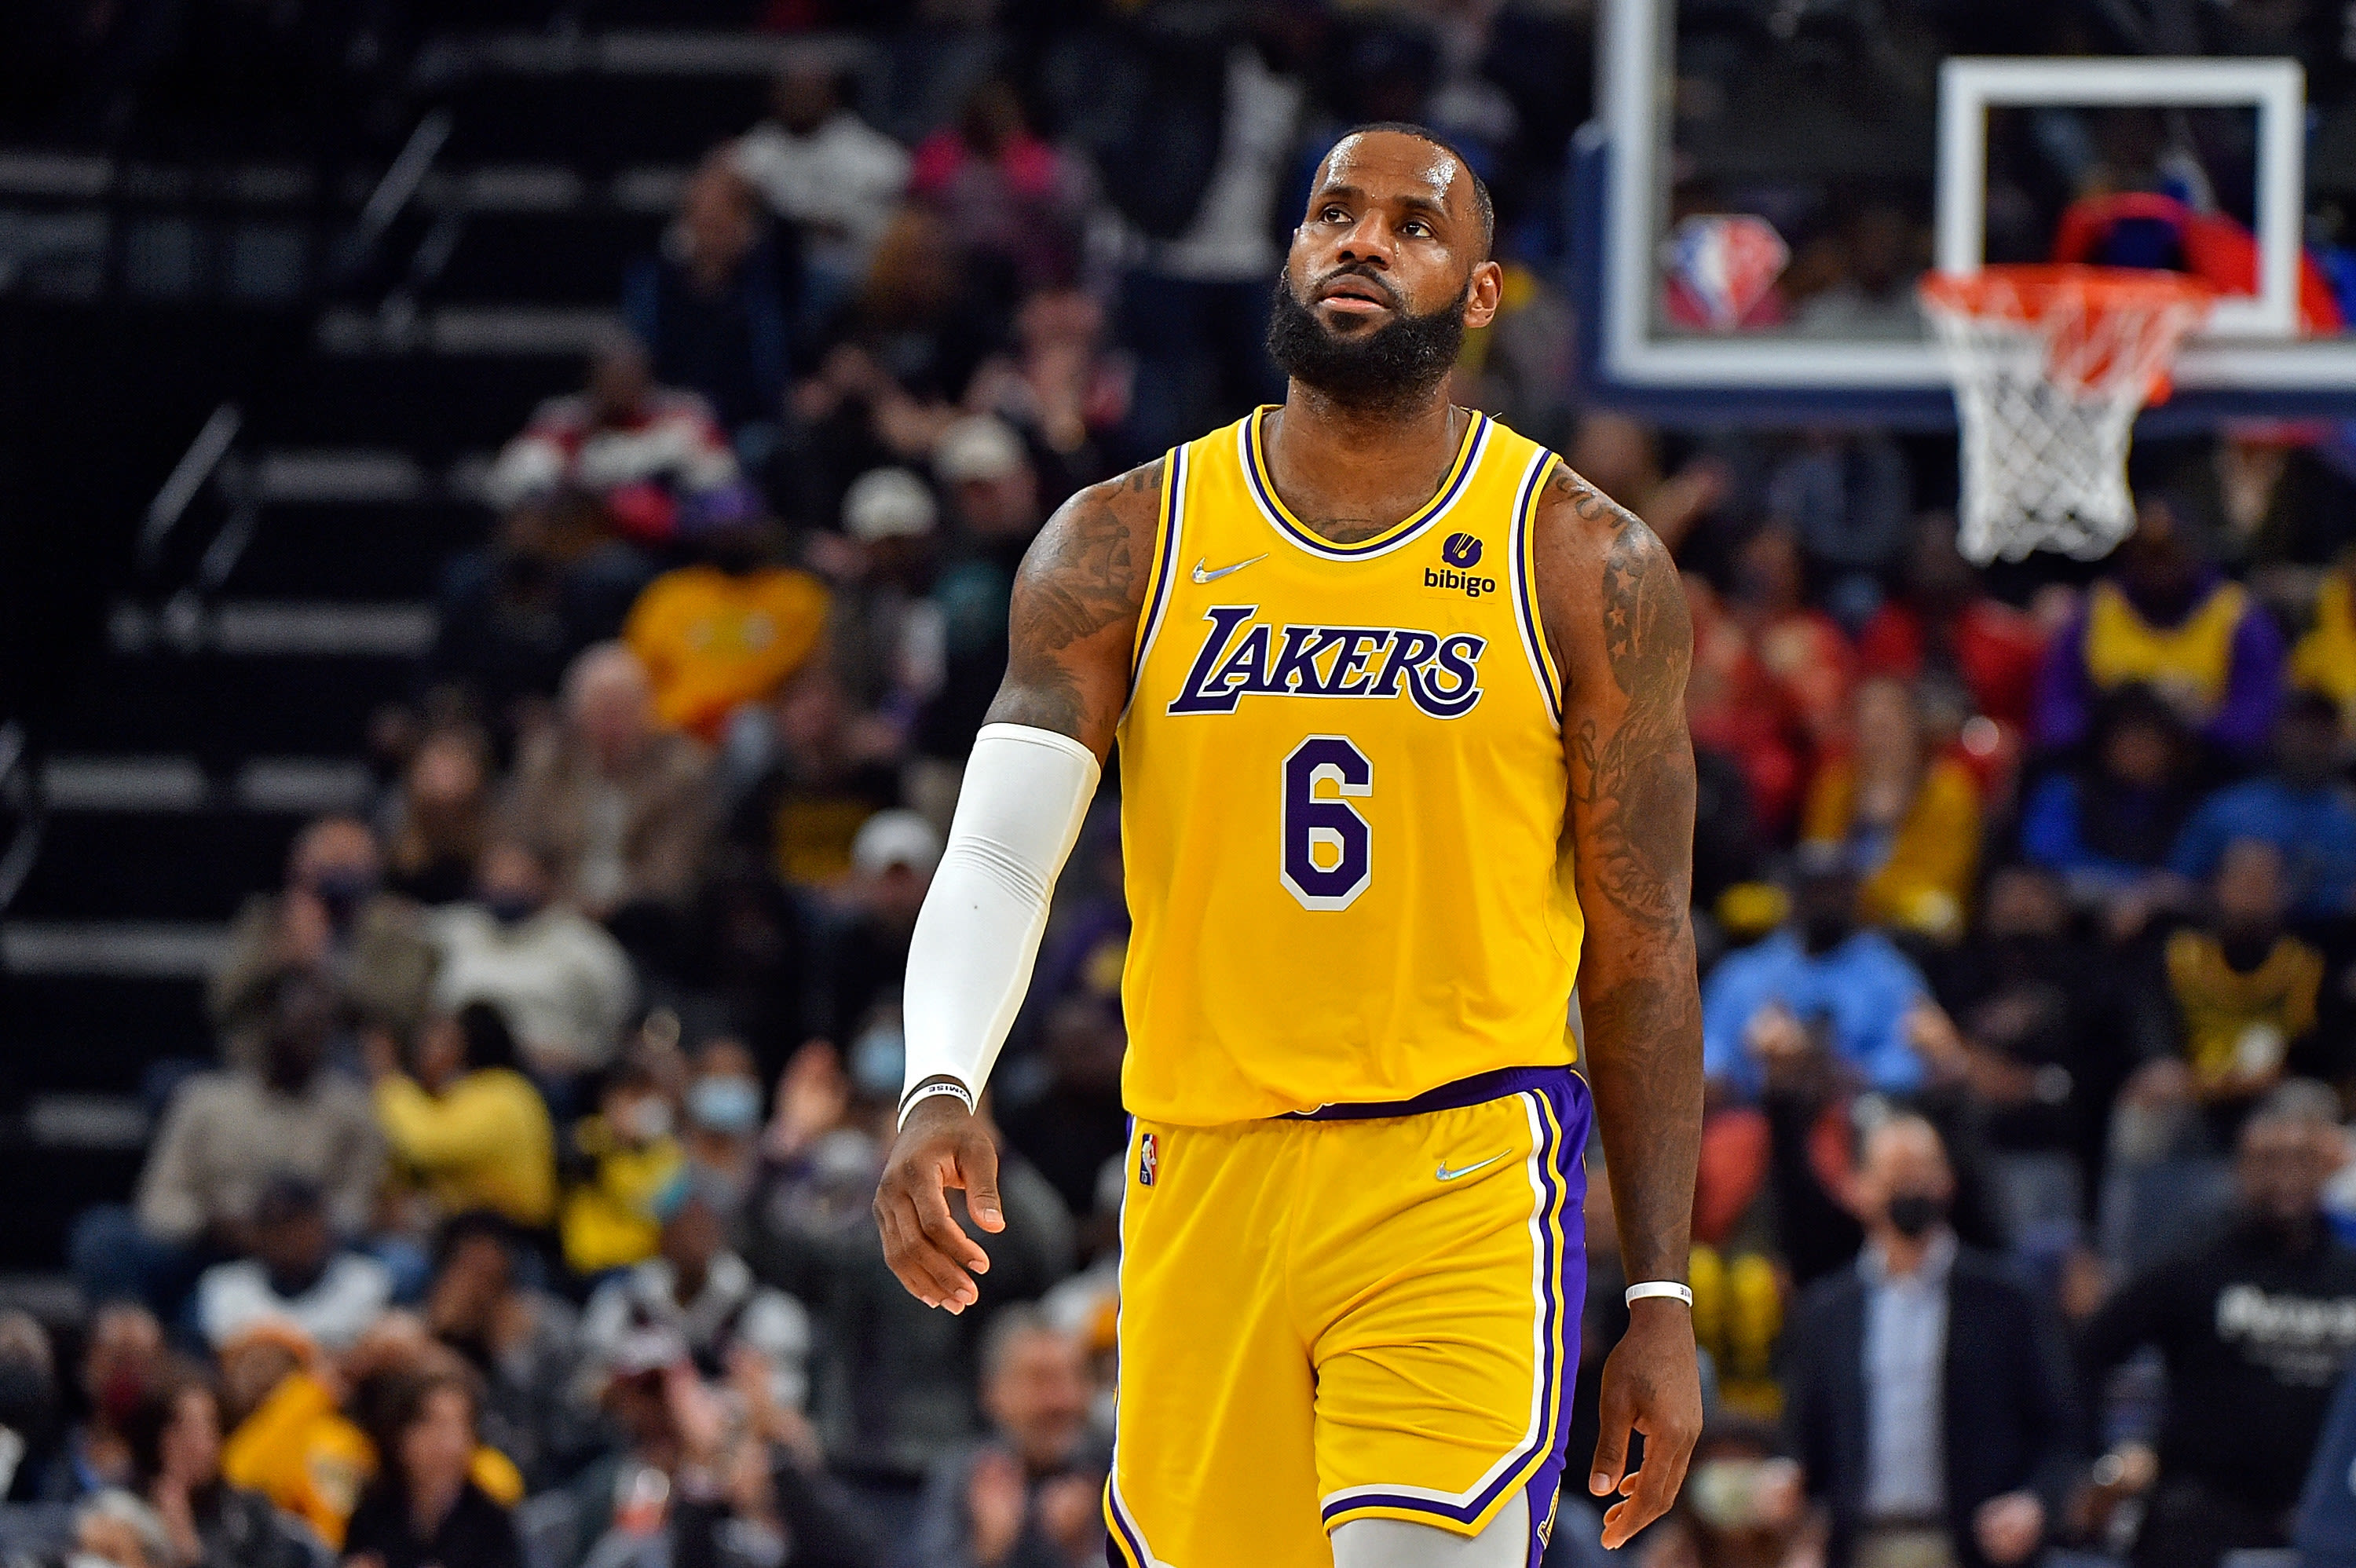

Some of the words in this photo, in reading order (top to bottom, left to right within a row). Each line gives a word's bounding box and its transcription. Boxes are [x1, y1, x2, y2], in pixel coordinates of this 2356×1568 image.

[1424, 568, 1495, 598] bibigo
[1166, 605, 1487, 720] LAKERS
[1280, 734, 1373, 911] 6
